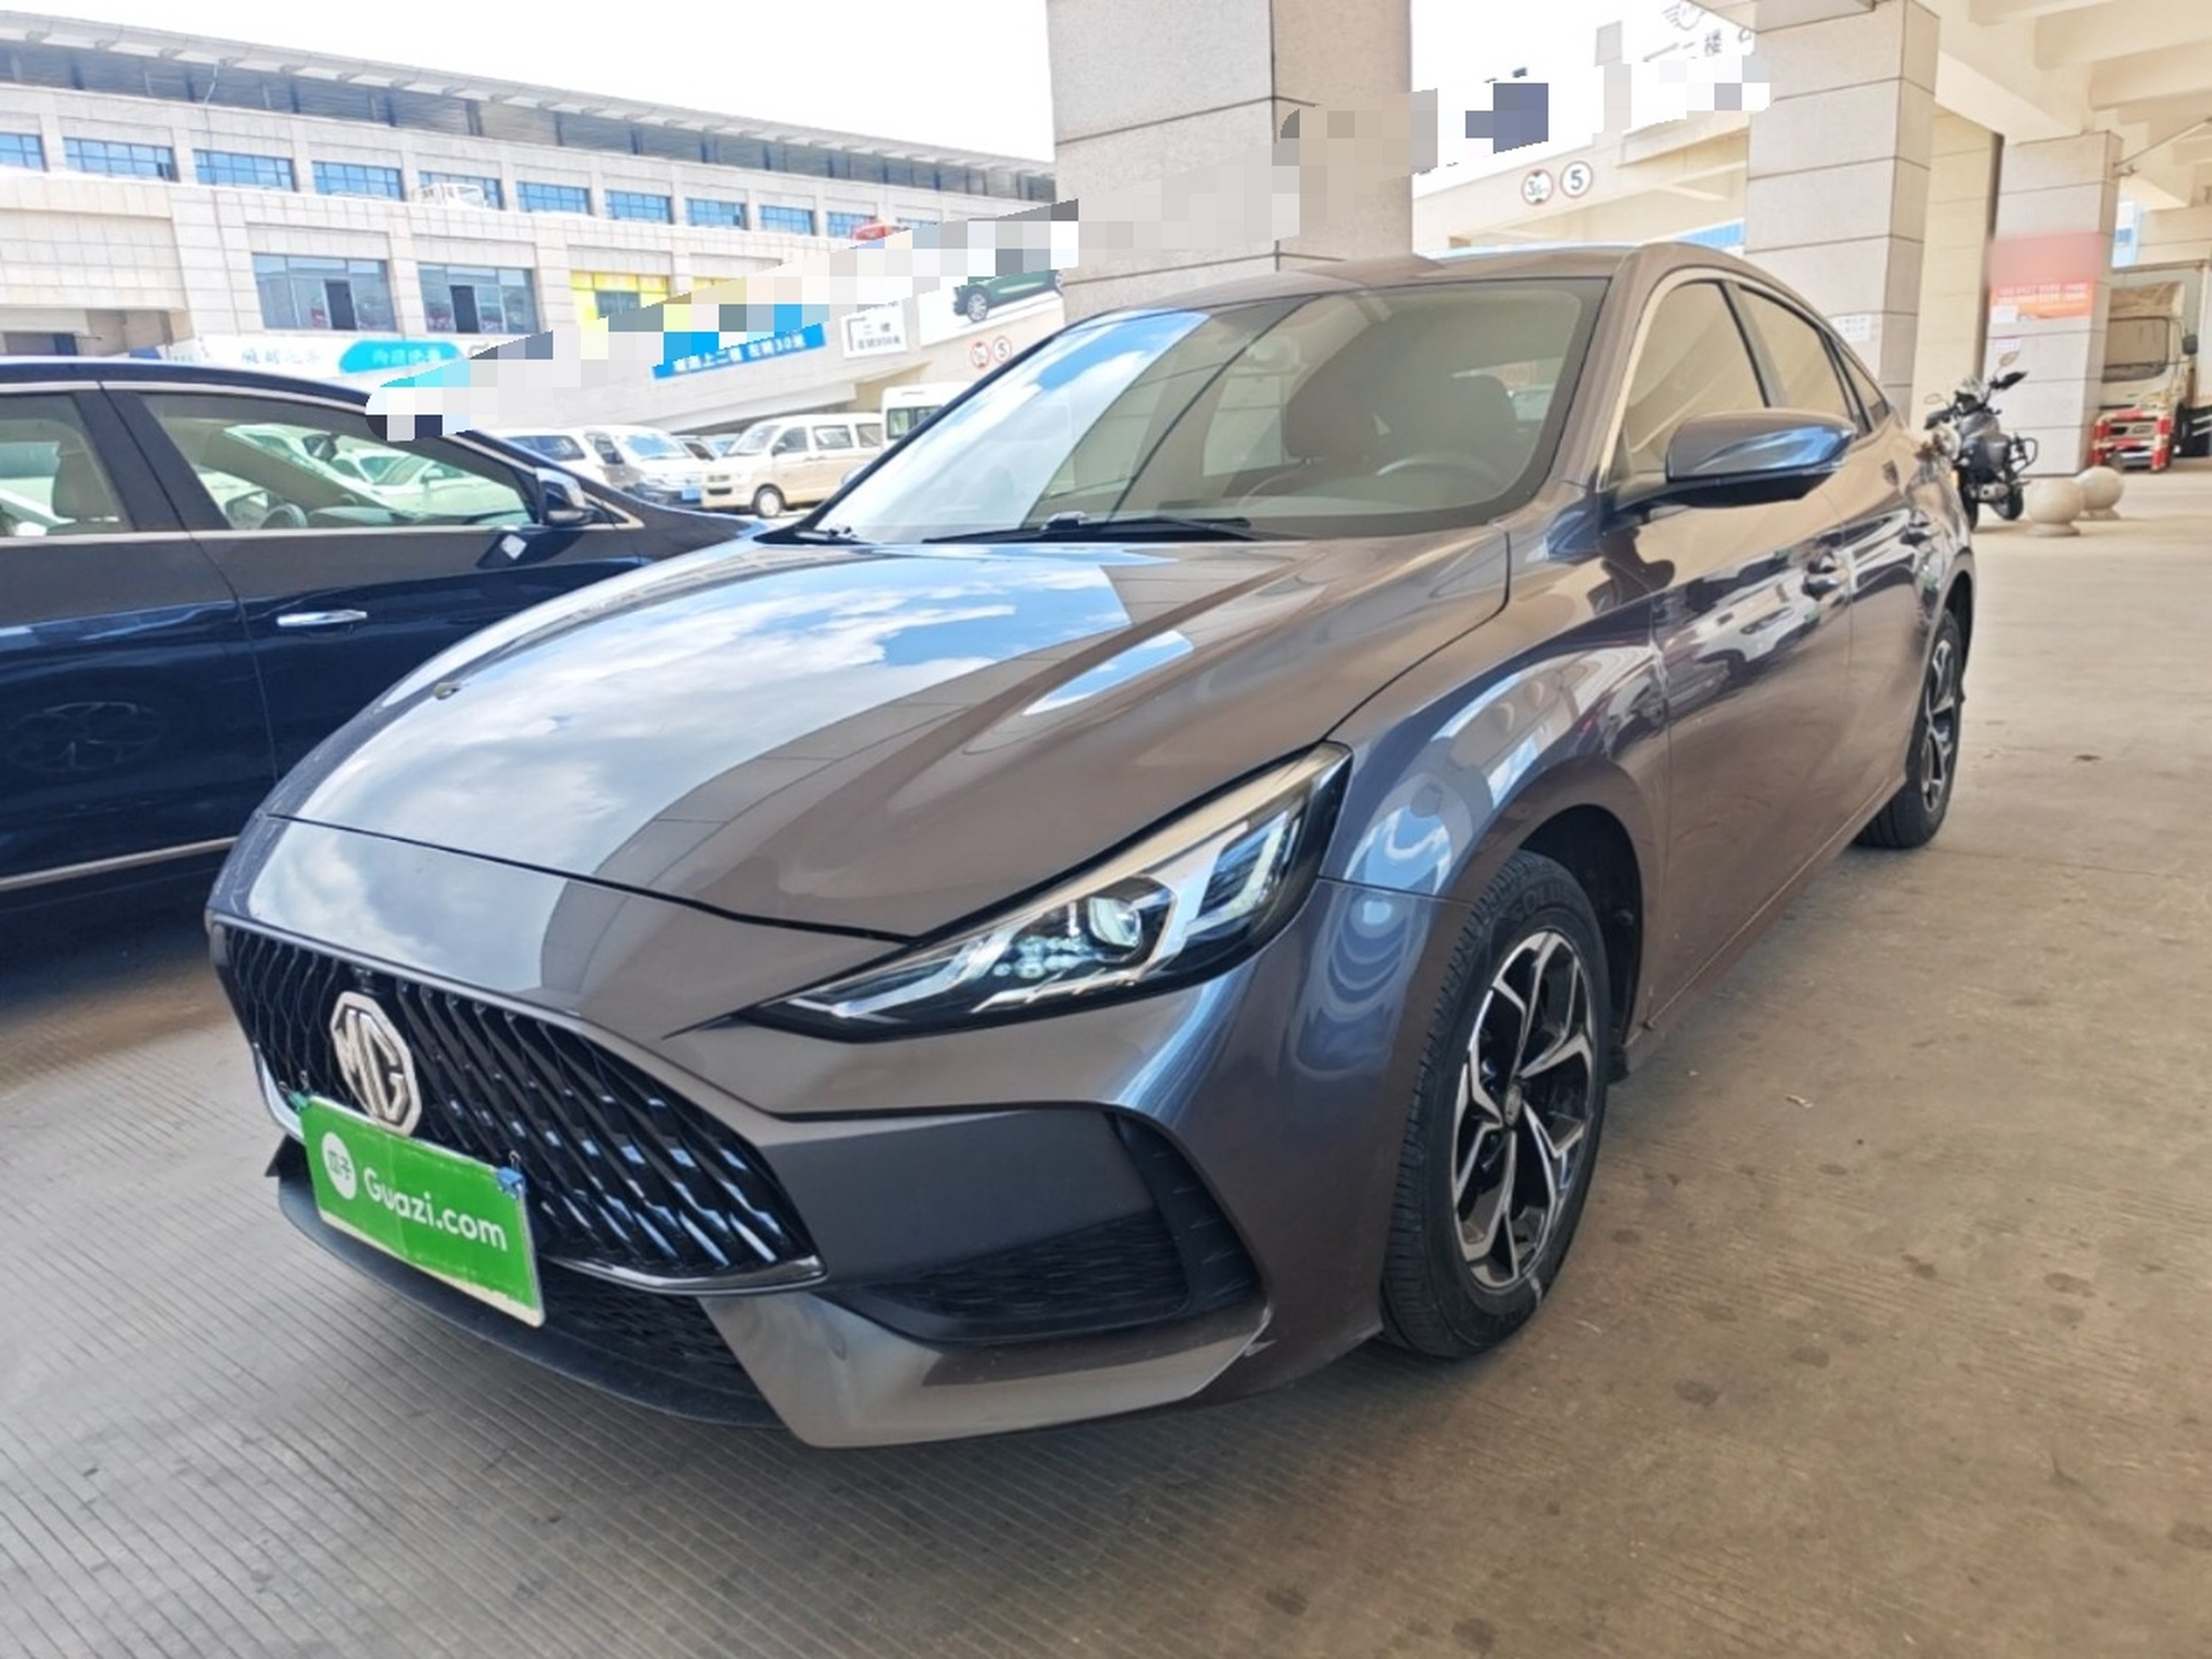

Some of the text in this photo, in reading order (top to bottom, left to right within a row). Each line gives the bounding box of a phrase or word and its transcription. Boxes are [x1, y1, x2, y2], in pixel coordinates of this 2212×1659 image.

[1570, 169, 1584, 190] 5
[334, 1008, 407, 1127] MG
[363, 1167, 507, 1252] Guazi.com
